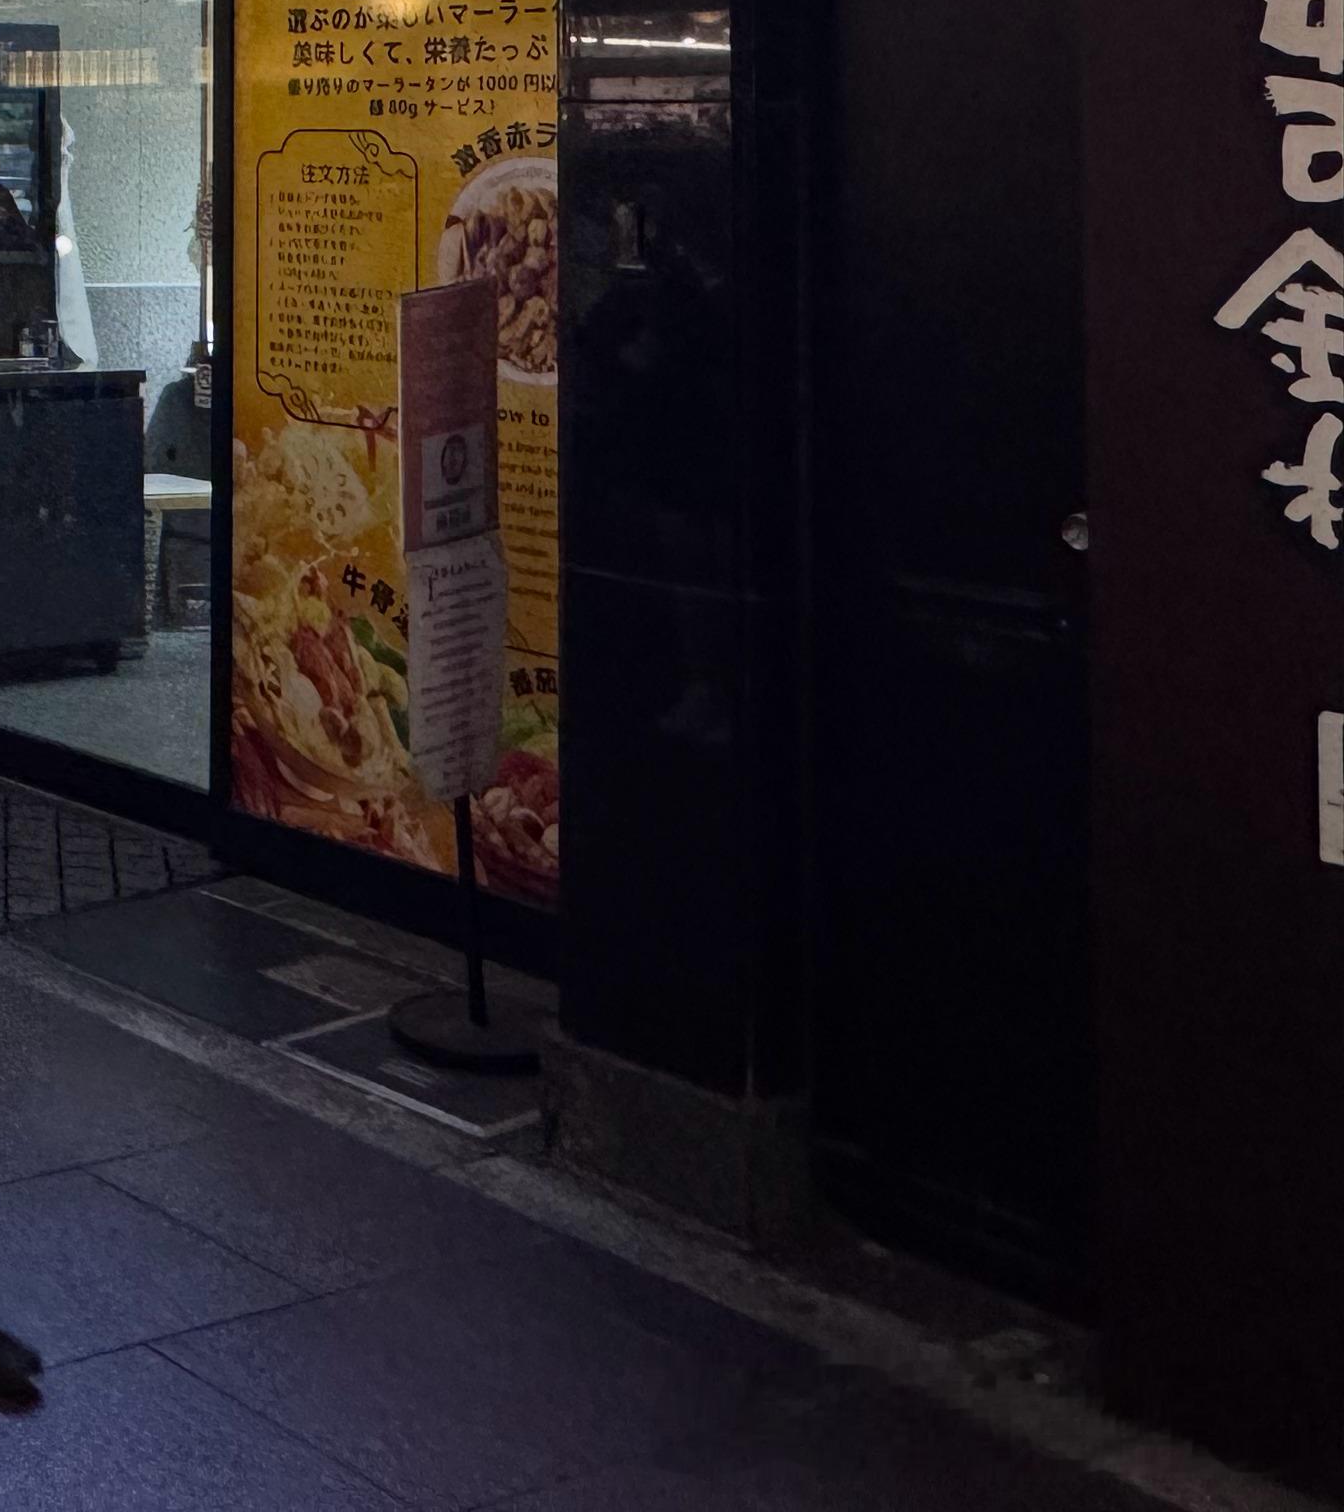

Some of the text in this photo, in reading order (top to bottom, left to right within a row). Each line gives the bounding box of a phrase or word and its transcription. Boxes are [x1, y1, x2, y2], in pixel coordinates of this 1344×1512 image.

[288, 0, 557, 34] 選ぶのが楽しいマーラー
